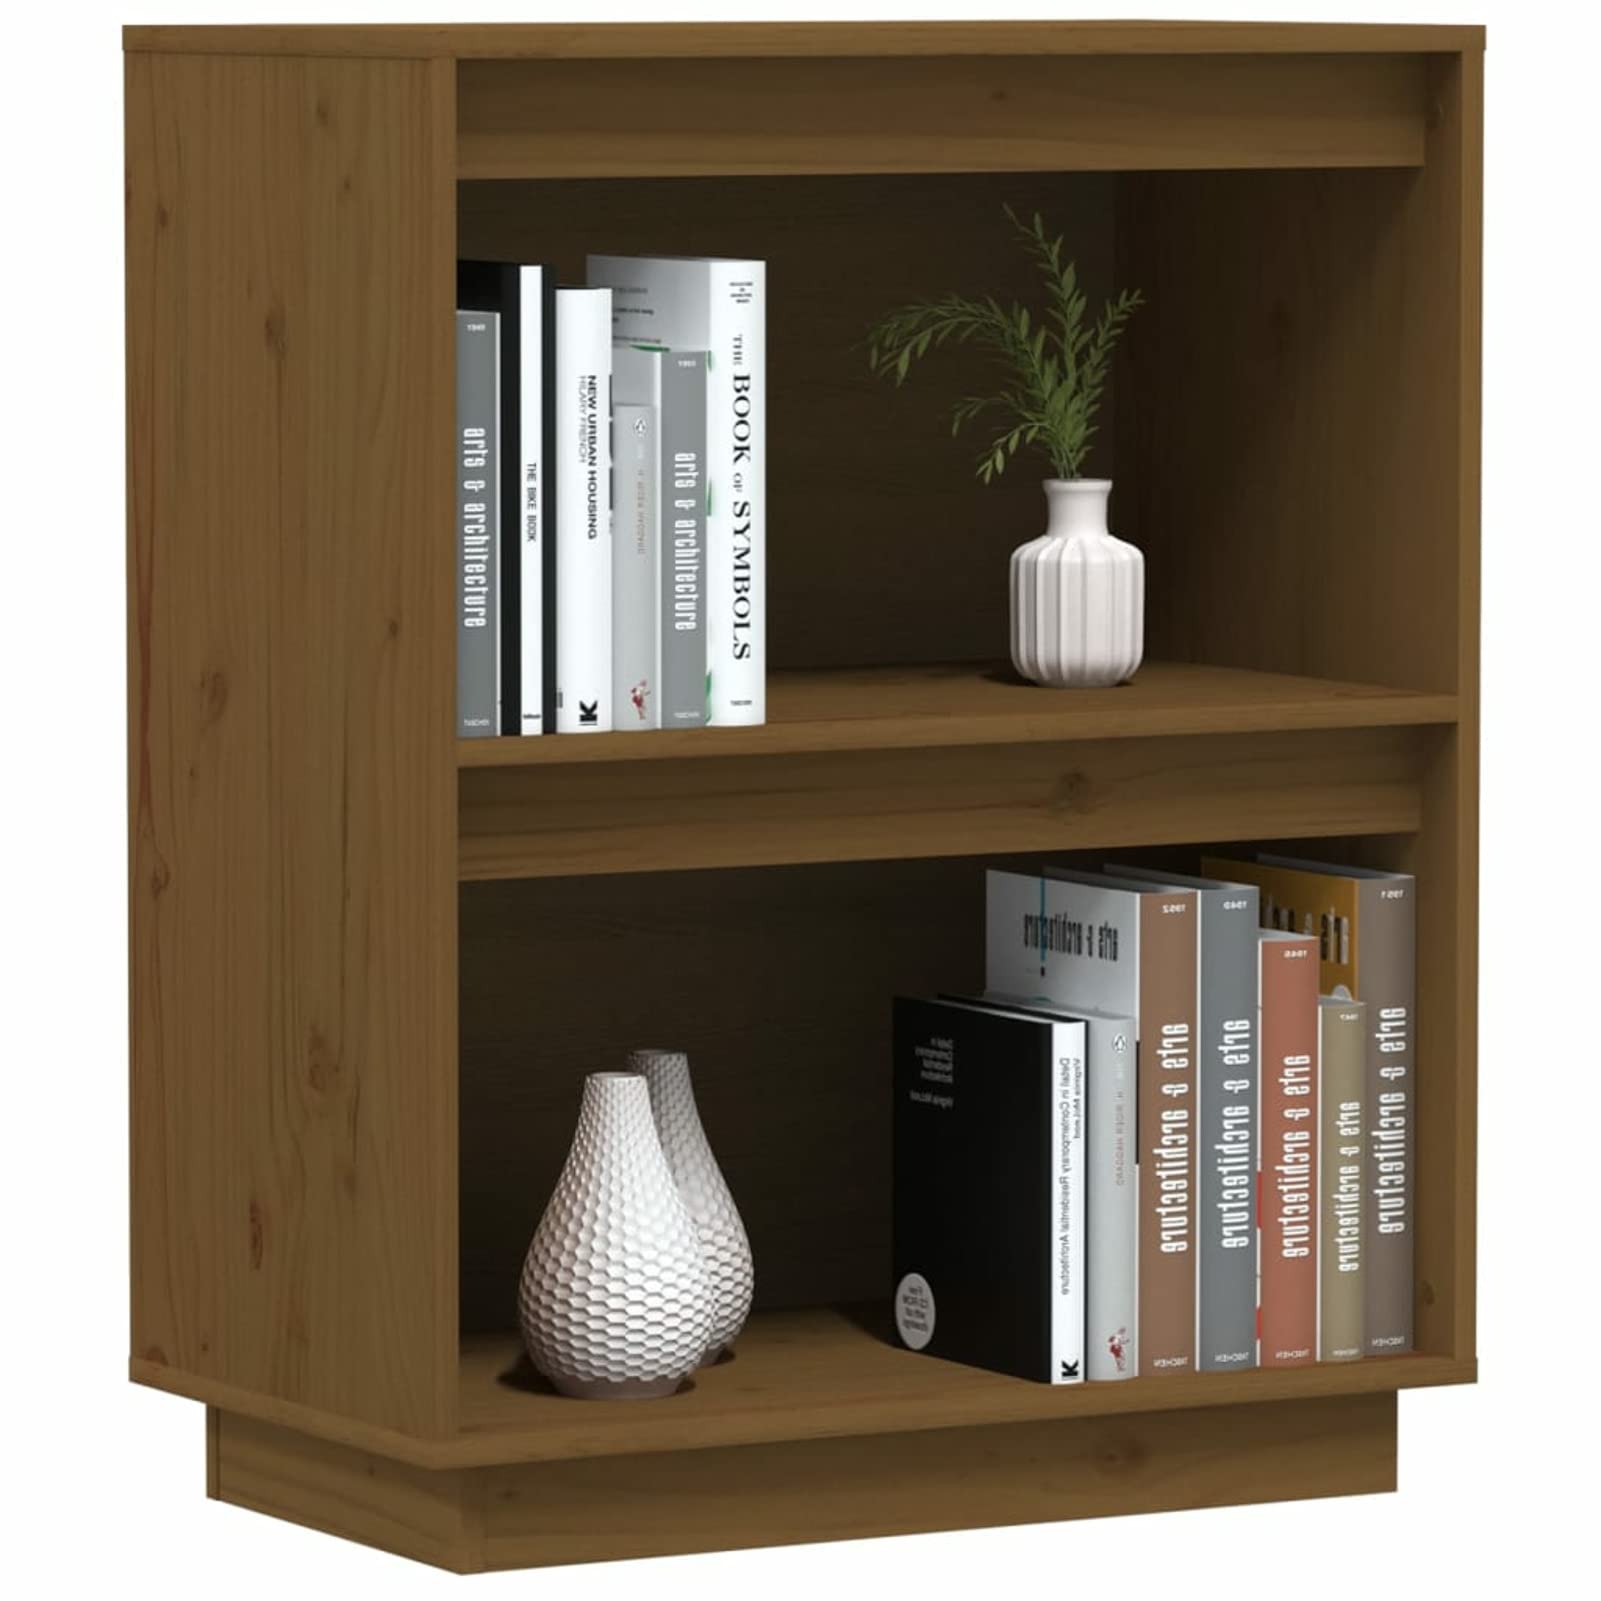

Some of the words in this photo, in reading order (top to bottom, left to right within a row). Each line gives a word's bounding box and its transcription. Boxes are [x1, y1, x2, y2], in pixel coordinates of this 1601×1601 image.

[732, 334, 743, 364] THE
[587, 375, 597, 409] NEW
[732, 374, 751, 464] BOOK
[463, 428, 488, 468] arts
[587, 414, 597, 466] URBAN
[526, 463, 537, 482] THE
[674, 453, 699, 488] arts
[526, 487, 537, 510] BIKE
[587, 470, 597, 540] HOUSING
[526, 515, 537, 542] BOOK
[463, 503, 488, 628] architecture
[674, 520, 700, 630] architecture
[732, 500, 751, 660] SYMBOLS
